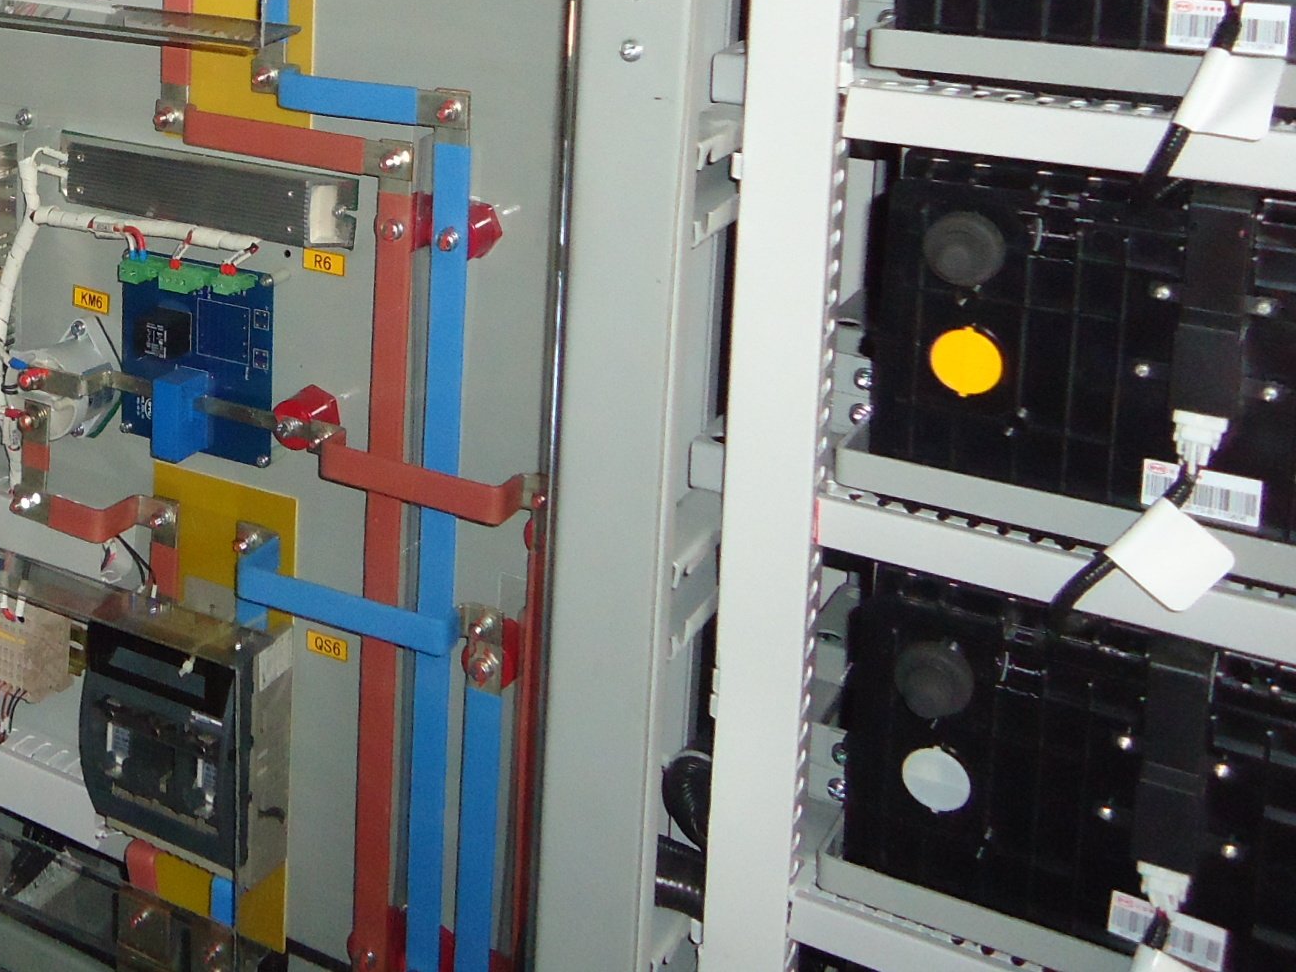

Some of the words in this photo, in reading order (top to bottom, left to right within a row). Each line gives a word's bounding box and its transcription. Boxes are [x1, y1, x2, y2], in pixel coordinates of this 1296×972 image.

[314, 254, 331, 270] R6
[80, 292, 103, 309] KM6
[314, 636, 341, 656] QS6
